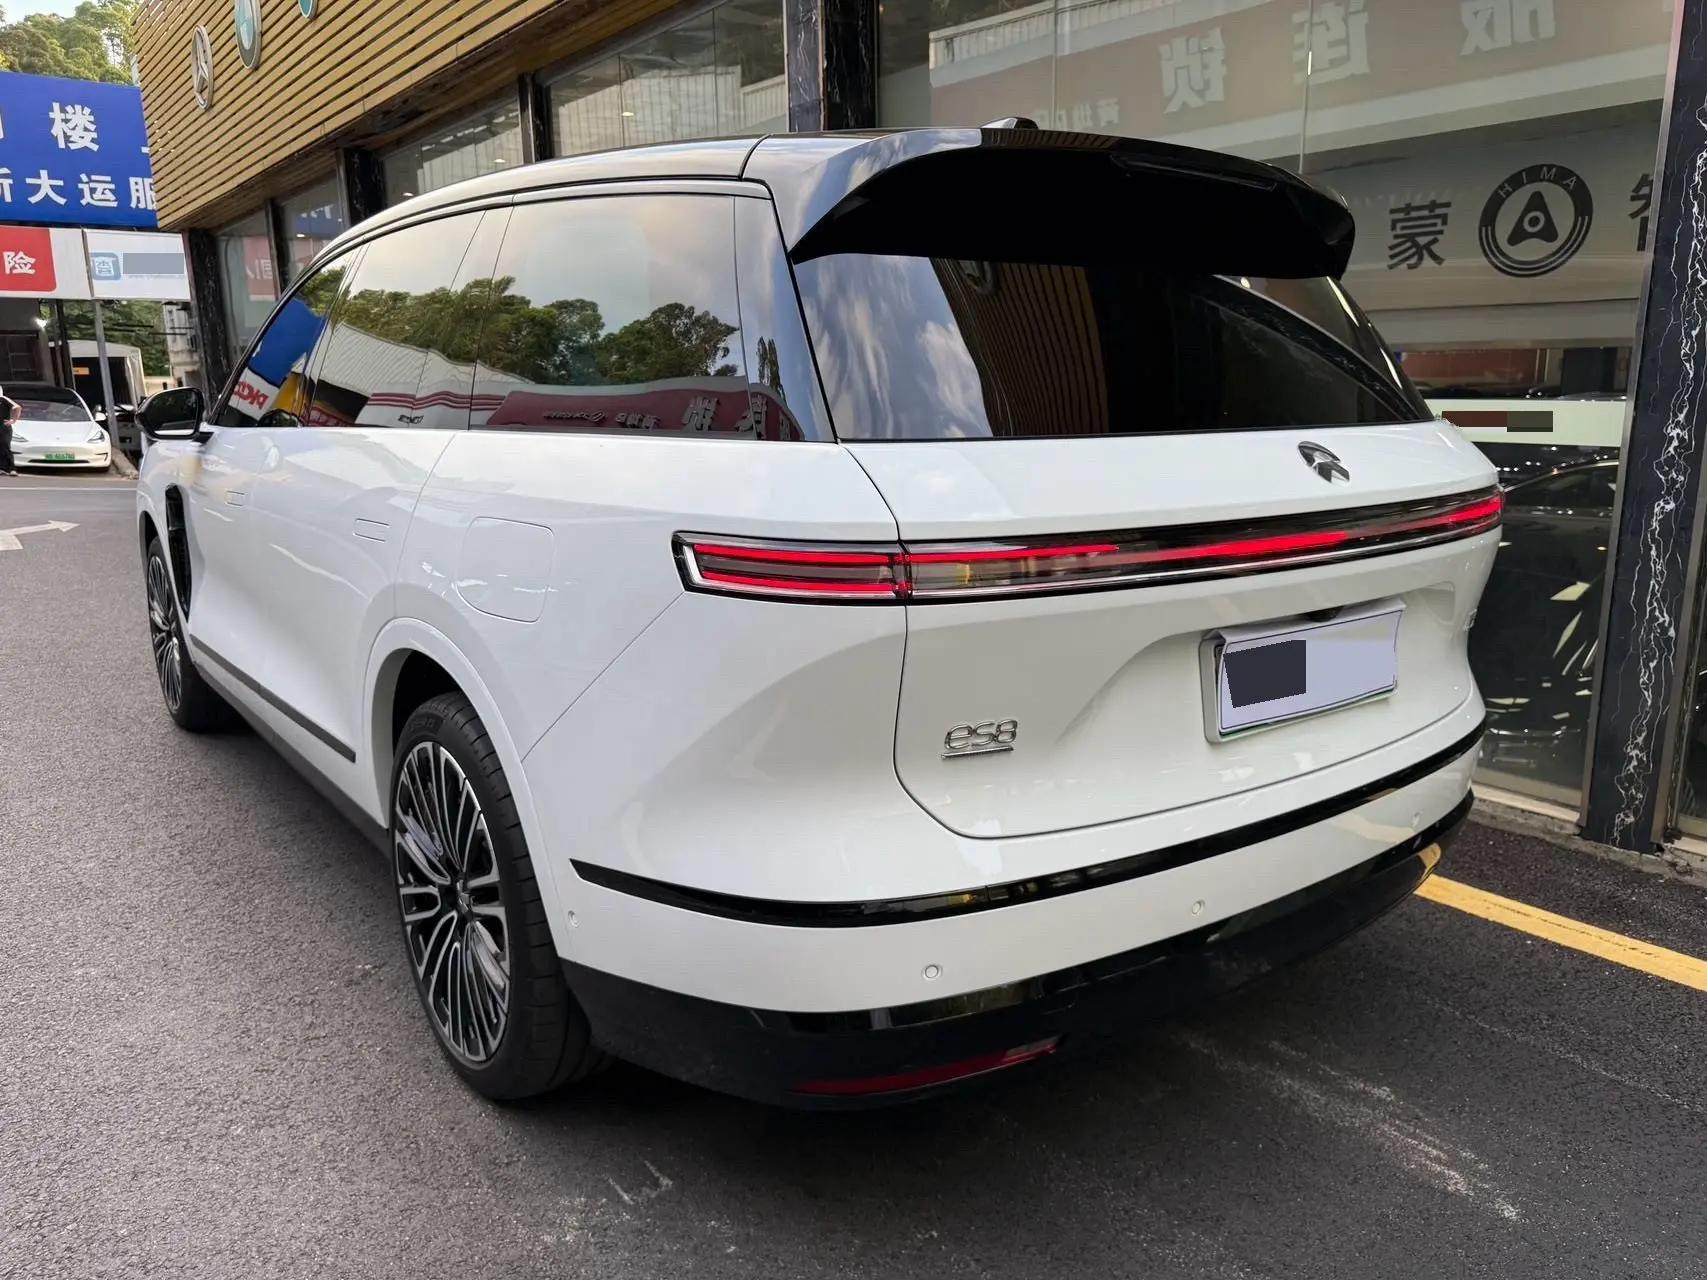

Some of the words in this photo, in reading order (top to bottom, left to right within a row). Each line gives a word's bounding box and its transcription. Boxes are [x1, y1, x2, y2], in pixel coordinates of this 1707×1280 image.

[49, 101, 99, 151] 楼
[1498, 166, 1577, 198] HIMA
[1387, 200, 1452, 270] 蒙
[3, 250, 36, 275] 险
